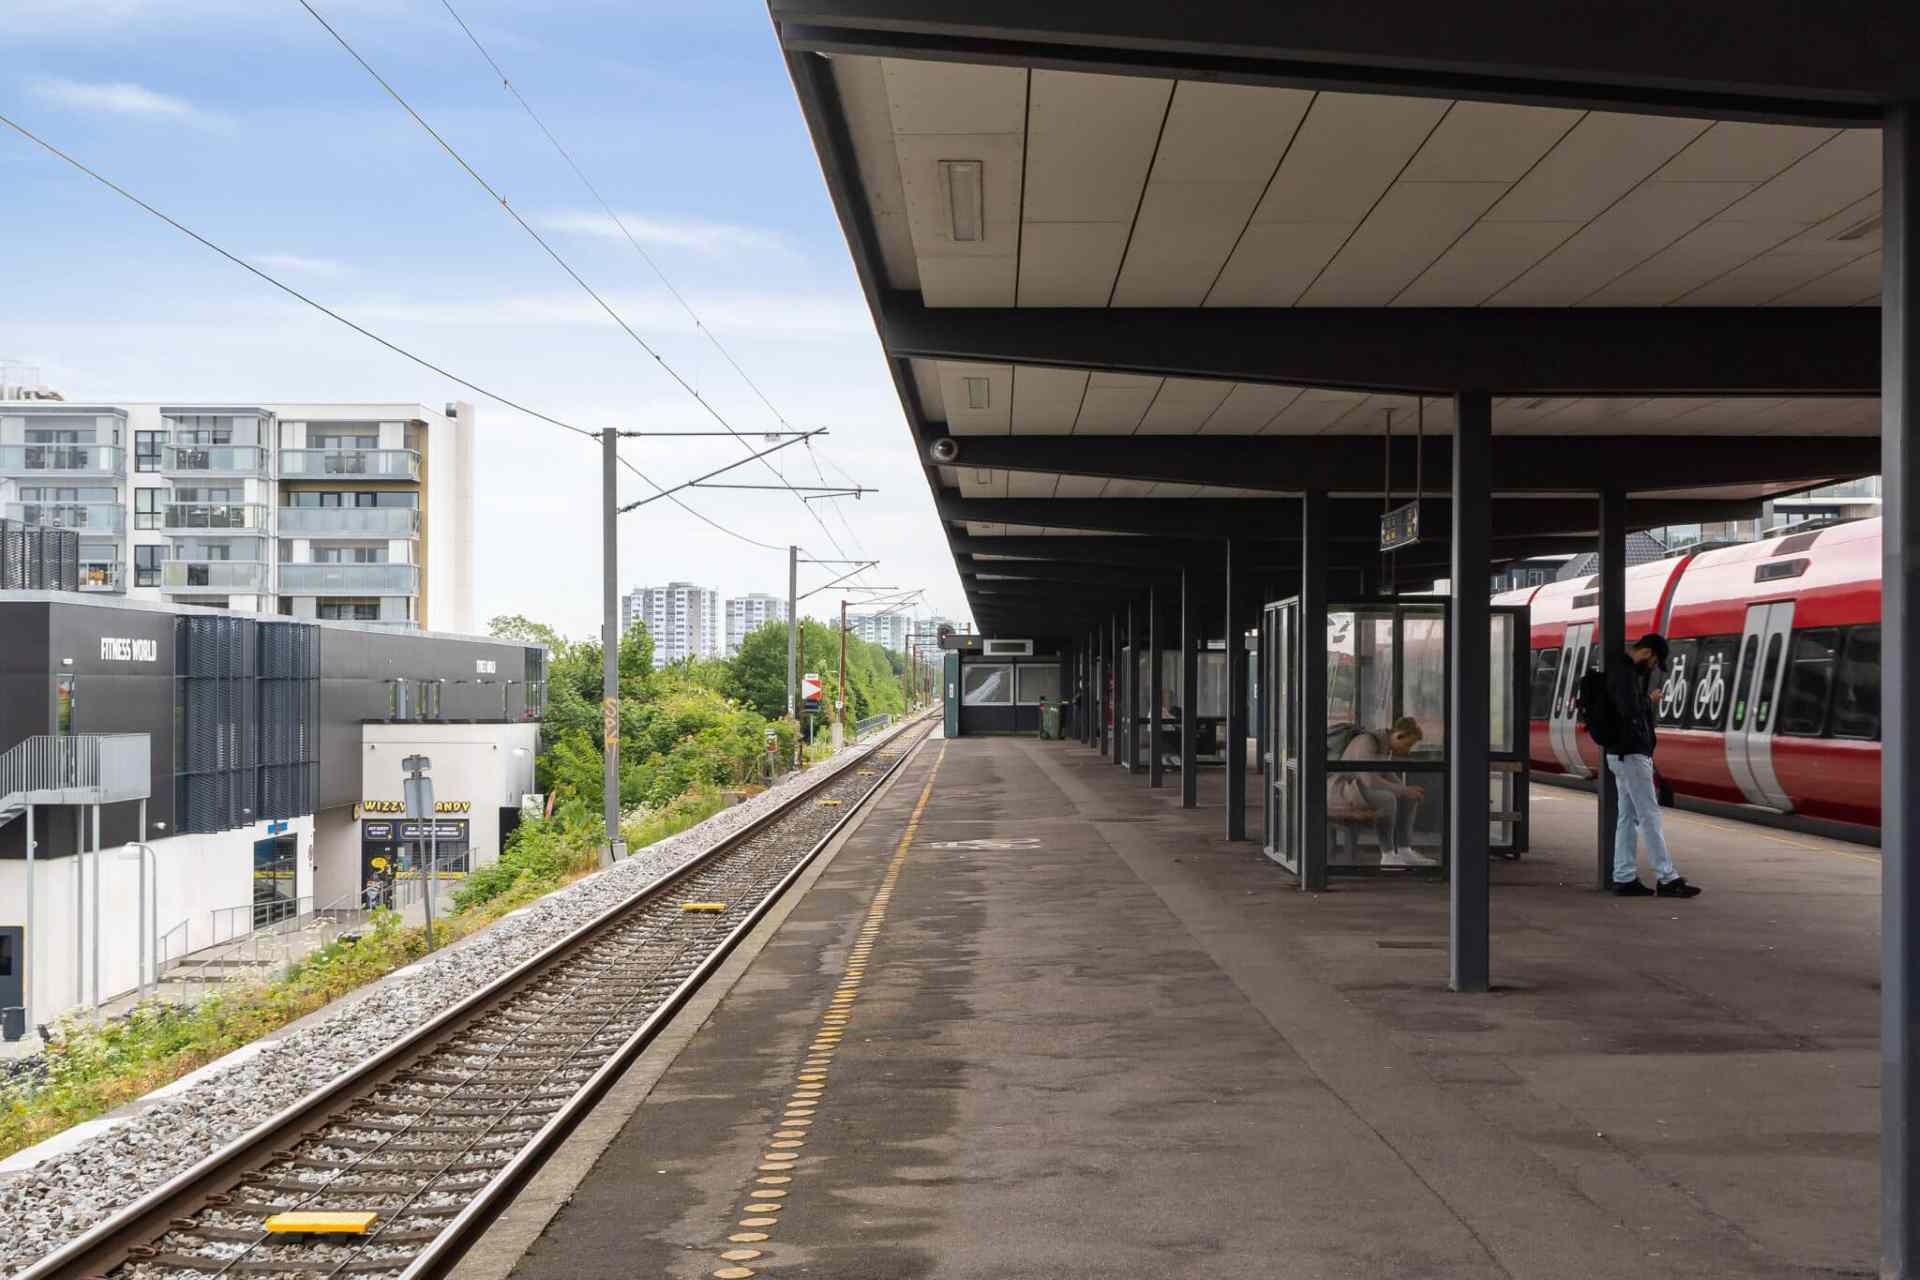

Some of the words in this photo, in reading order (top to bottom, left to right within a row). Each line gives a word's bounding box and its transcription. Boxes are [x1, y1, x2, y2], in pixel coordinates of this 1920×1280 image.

[101, 637, 131, 660] FITNESS
[132, 639, 157, 661] WORLD
[364, 801, 406, 813] WIZZY
[434, 801, 470, 813] ANDY
